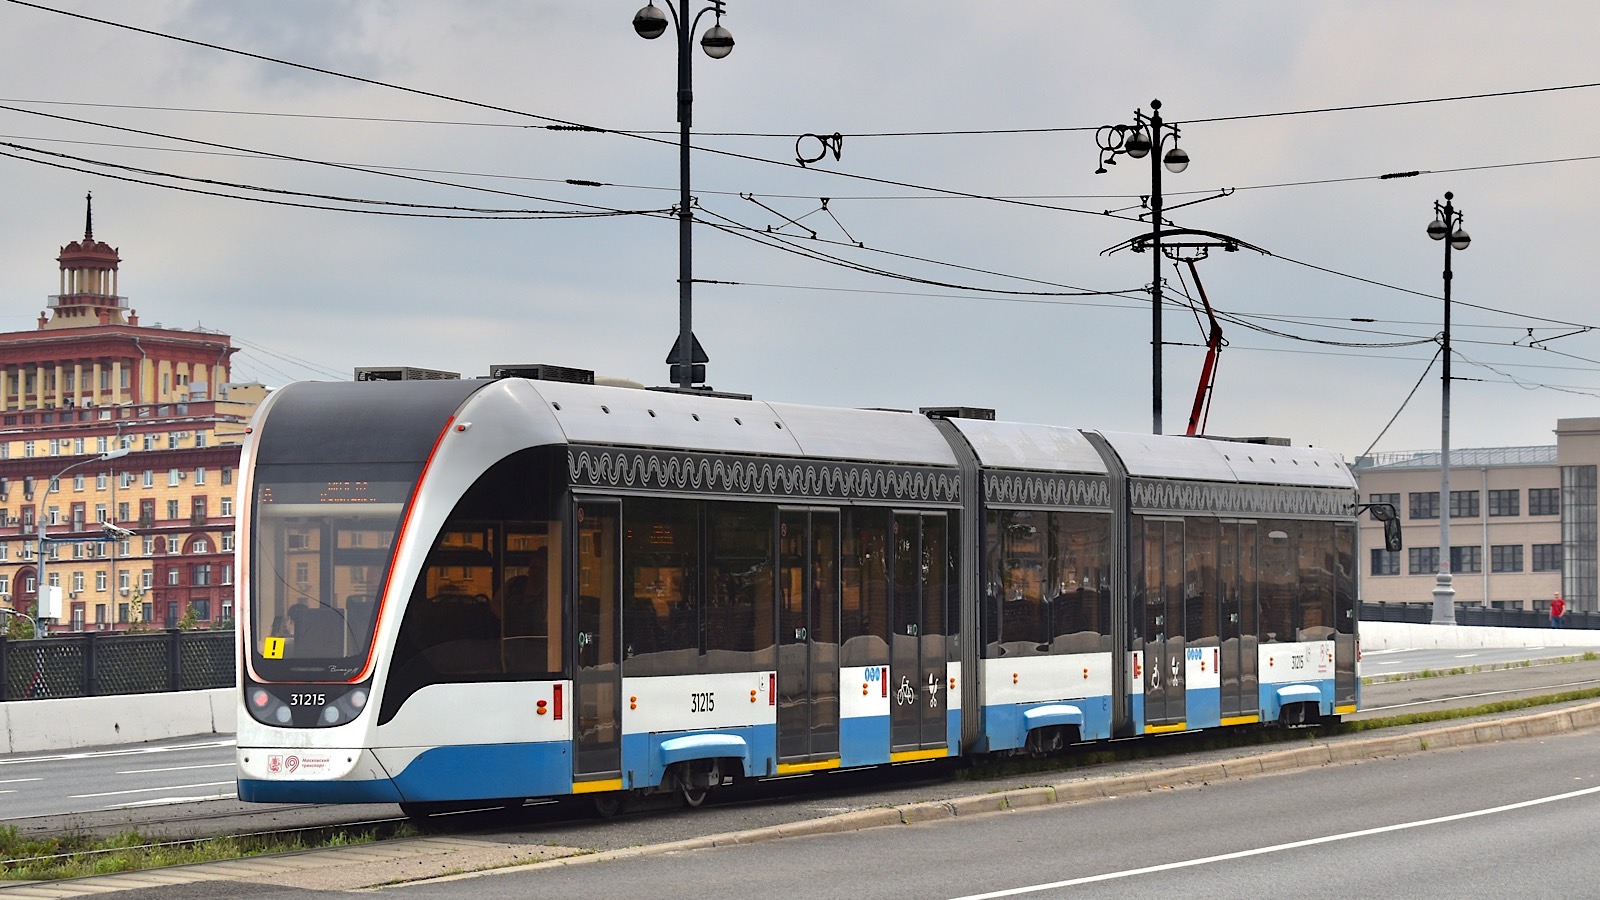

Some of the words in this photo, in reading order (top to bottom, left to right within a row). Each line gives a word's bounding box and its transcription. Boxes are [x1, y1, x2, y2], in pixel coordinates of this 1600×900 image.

[1291, 655, 1304, 670] 31215
[290, 693, 326, 706] 31215
[691, 692, 715, 713] 31215
